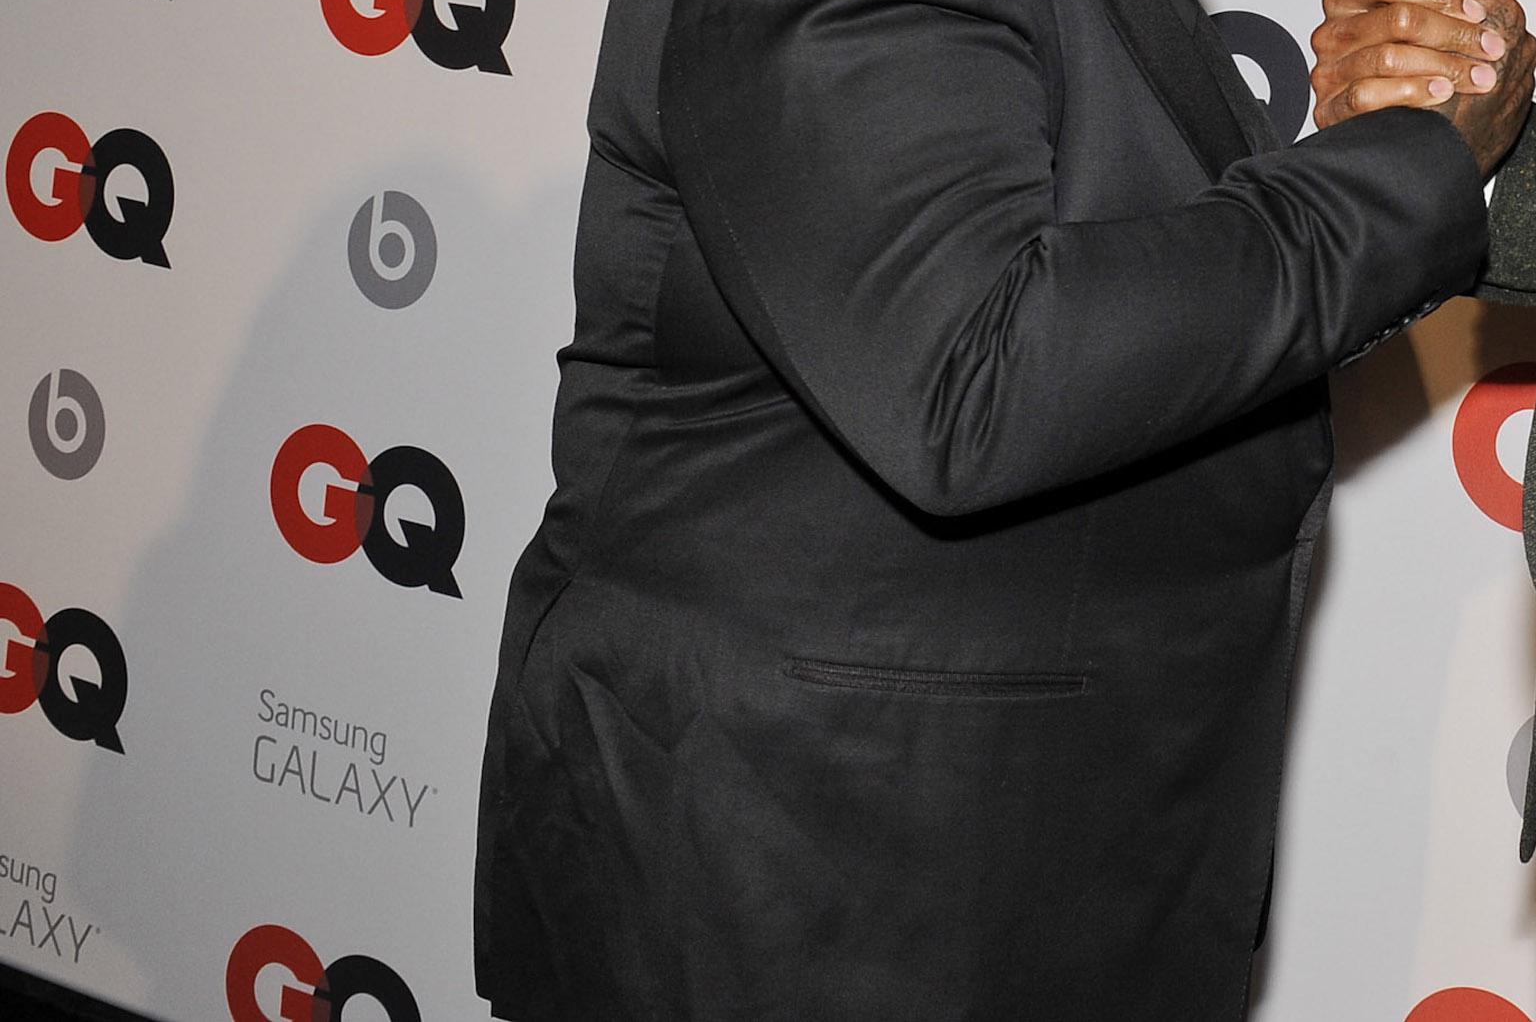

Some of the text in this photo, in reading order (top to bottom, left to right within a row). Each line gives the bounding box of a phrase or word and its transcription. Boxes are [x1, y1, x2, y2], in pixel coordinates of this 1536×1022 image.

[5, 112, 175, 270] GQ
[270, 424, 465, 600] GQ
[257, 689, 387, 765] Samsung
